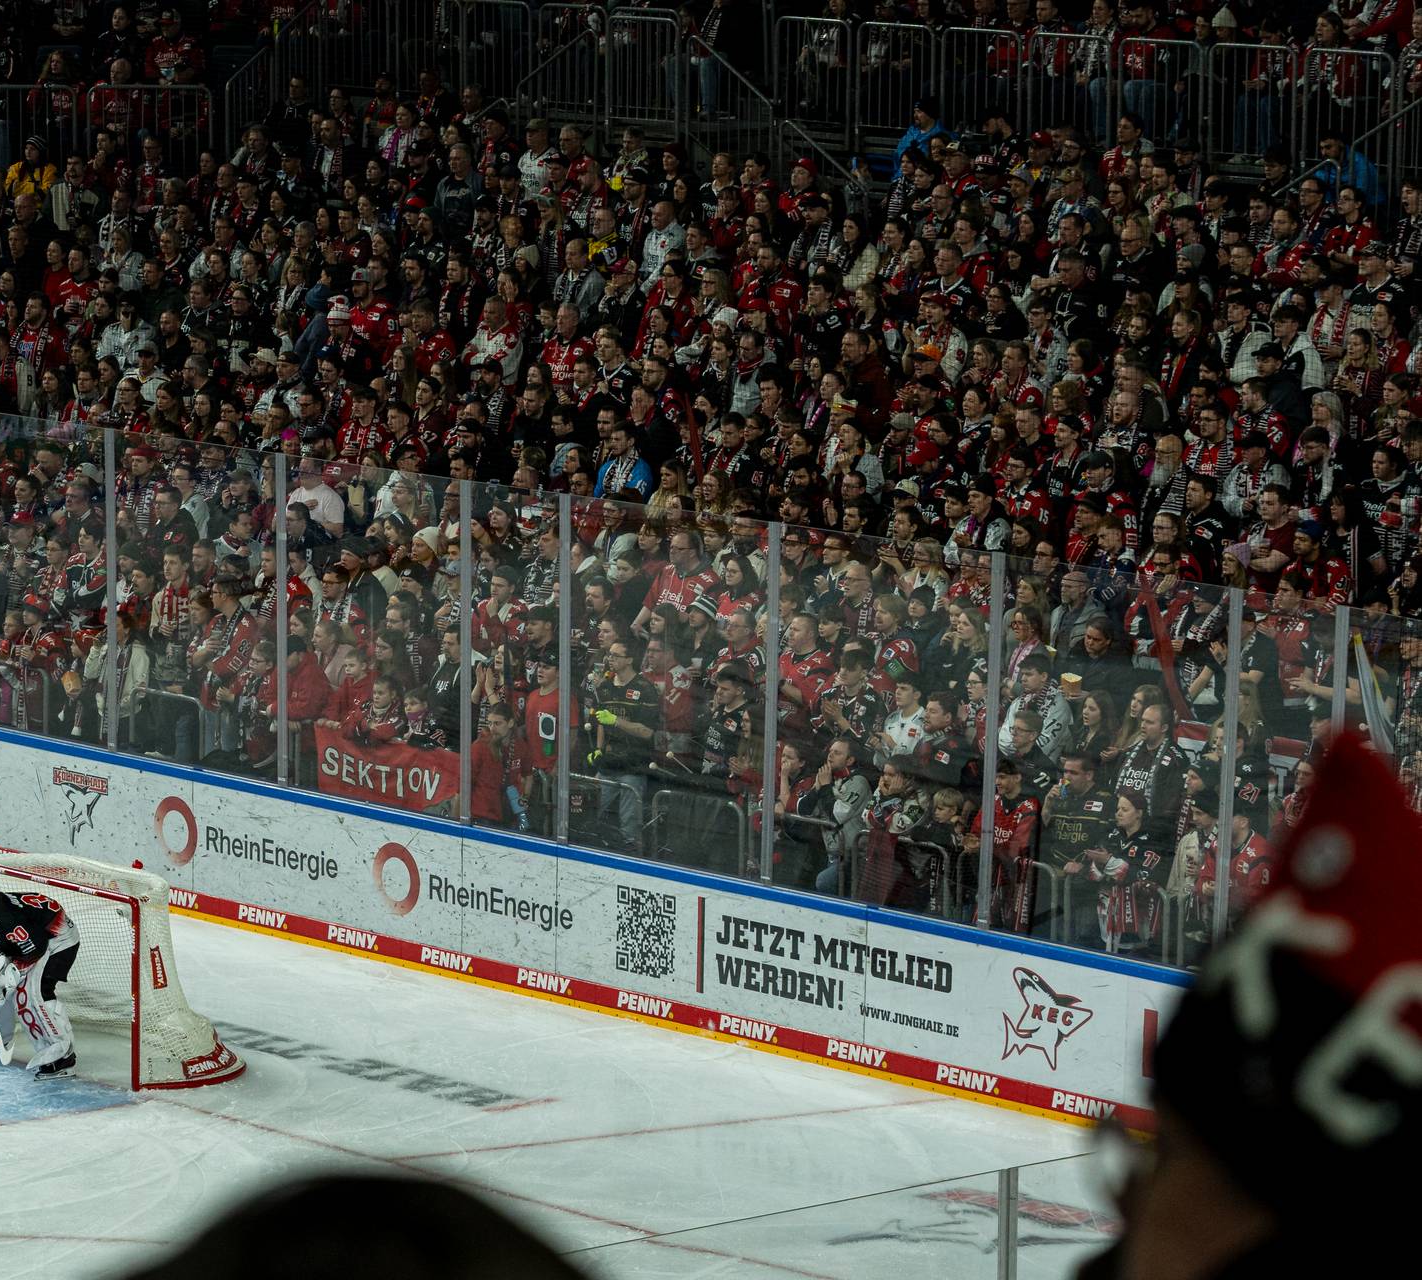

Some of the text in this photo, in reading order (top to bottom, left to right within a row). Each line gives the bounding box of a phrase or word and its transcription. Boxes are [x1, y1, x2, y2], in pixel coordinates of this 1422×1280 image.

[1038, 507, 1049, 525] 15
[321, 746, 441, 801] SEKTION
[205, 825, 339, 881] RheinEnergie
[429, 873, 574, 932] RheinEnergie
[716, 914, 954, 994] JETZT MITGLIED
[716, 953, 845, 1011] WERDEN!
[859, 1003, 960, 1038] WWW.JUNGHAIE.DE
[1031, 1003, 1074, 1027] KEC
